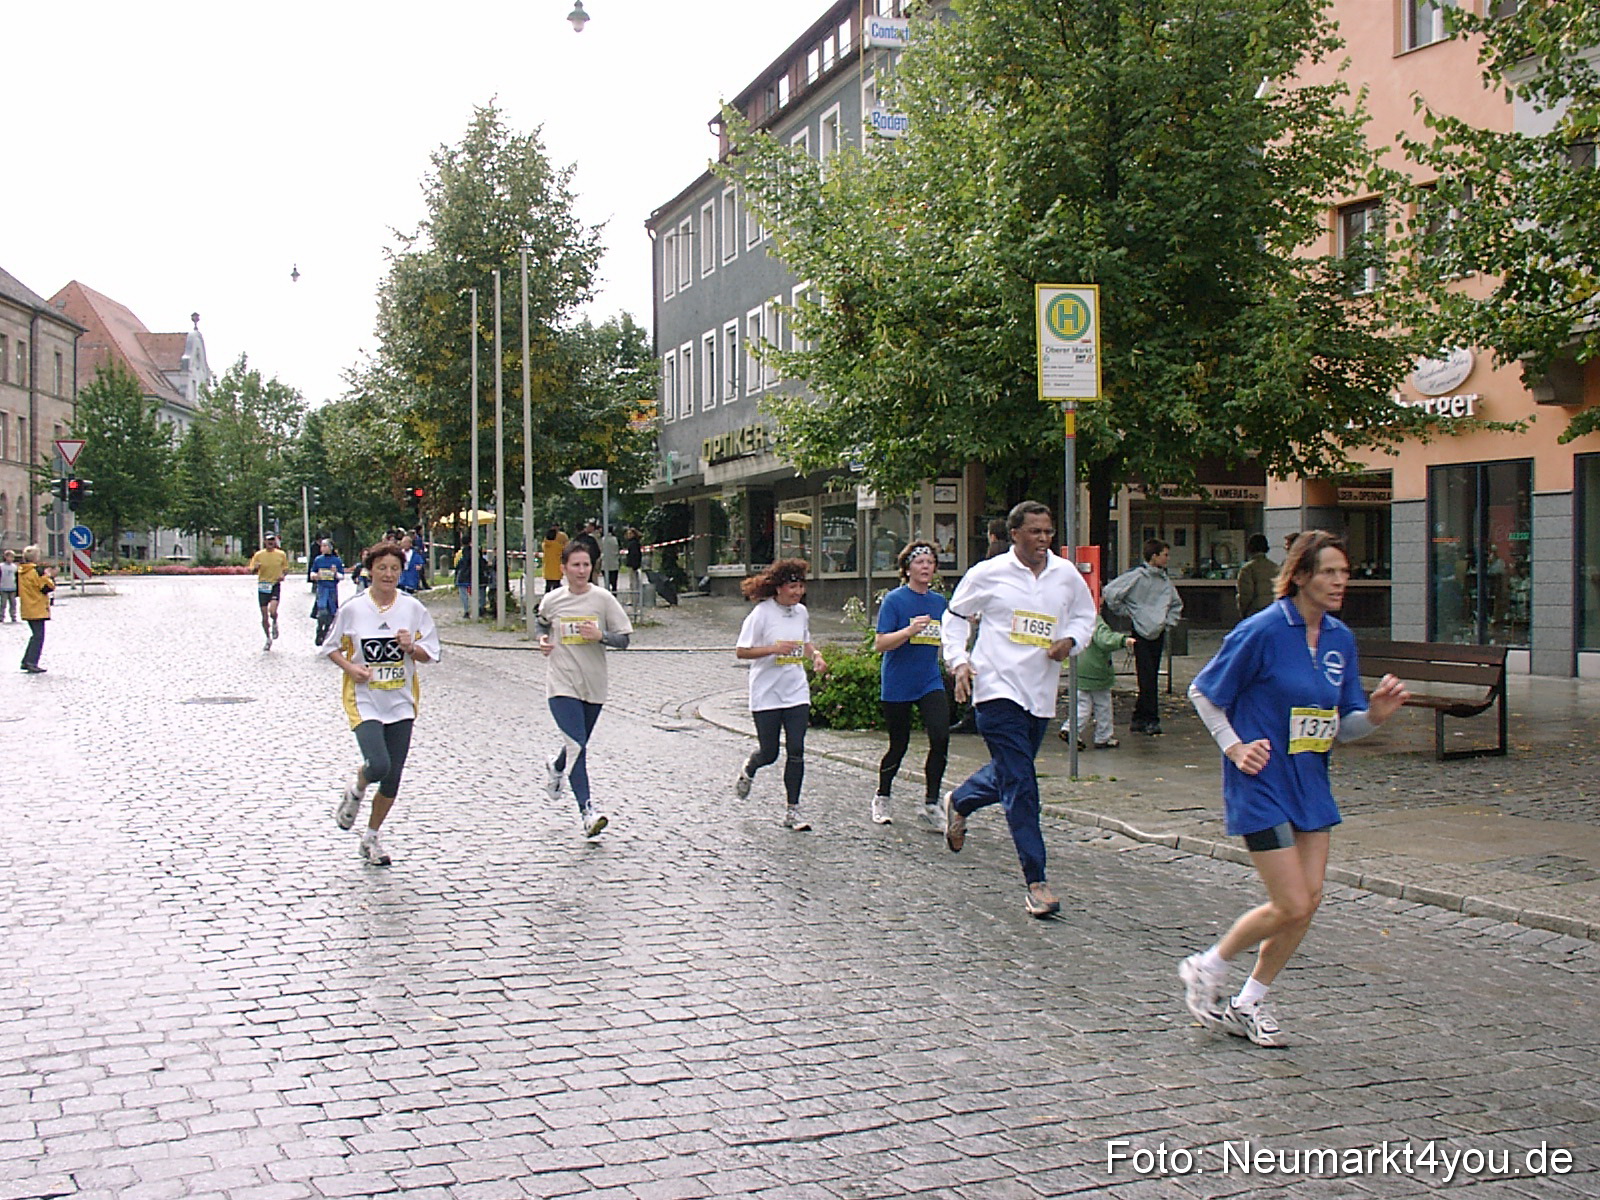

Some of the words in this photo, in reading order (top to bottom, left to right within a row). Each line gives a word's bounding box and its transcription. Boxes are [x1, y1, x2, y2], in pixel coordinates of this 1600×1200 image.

[1058, 303, 1079, 330] H
[702, 422, 766, 462] OPTIKER
[579, 471, 599, 487] WC
[1022, 618, 1053, 637] 1695
